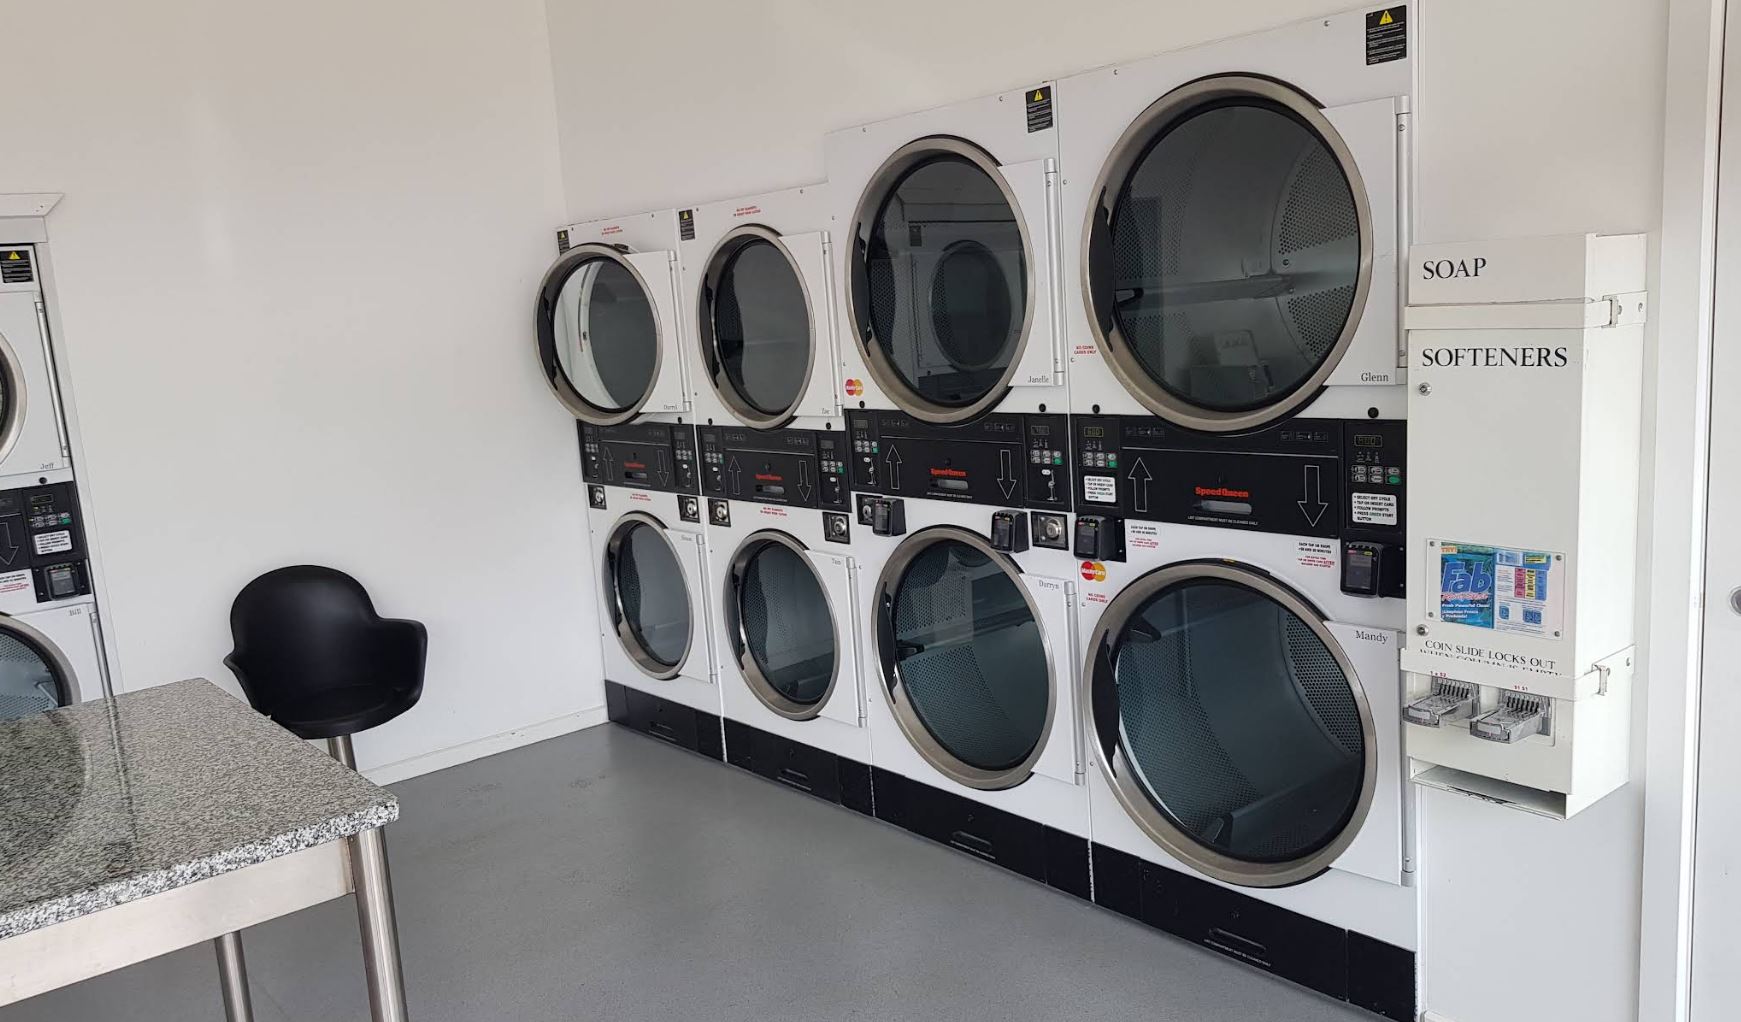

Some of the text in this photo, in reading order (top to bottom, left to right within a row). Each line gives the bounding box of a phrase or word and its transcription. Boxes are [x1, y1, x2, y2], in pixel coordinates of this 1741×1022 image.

[1423, 257, 1487, 280] SOAP
[1421, 346, 1568, 368] SOFTENERS
[1360, 371, 1389, 382] Glenn
[1441, 561, 1493, 593] Fab
[1355, 630, 1388, 645] Mandy
[1424, 639, 1452, 652] COIN
[1455, 645, 1485, 658] SLIDE
[1488, 650, 1526, 665] LOCKS
[1529, 657, 1556, 670] OUT
